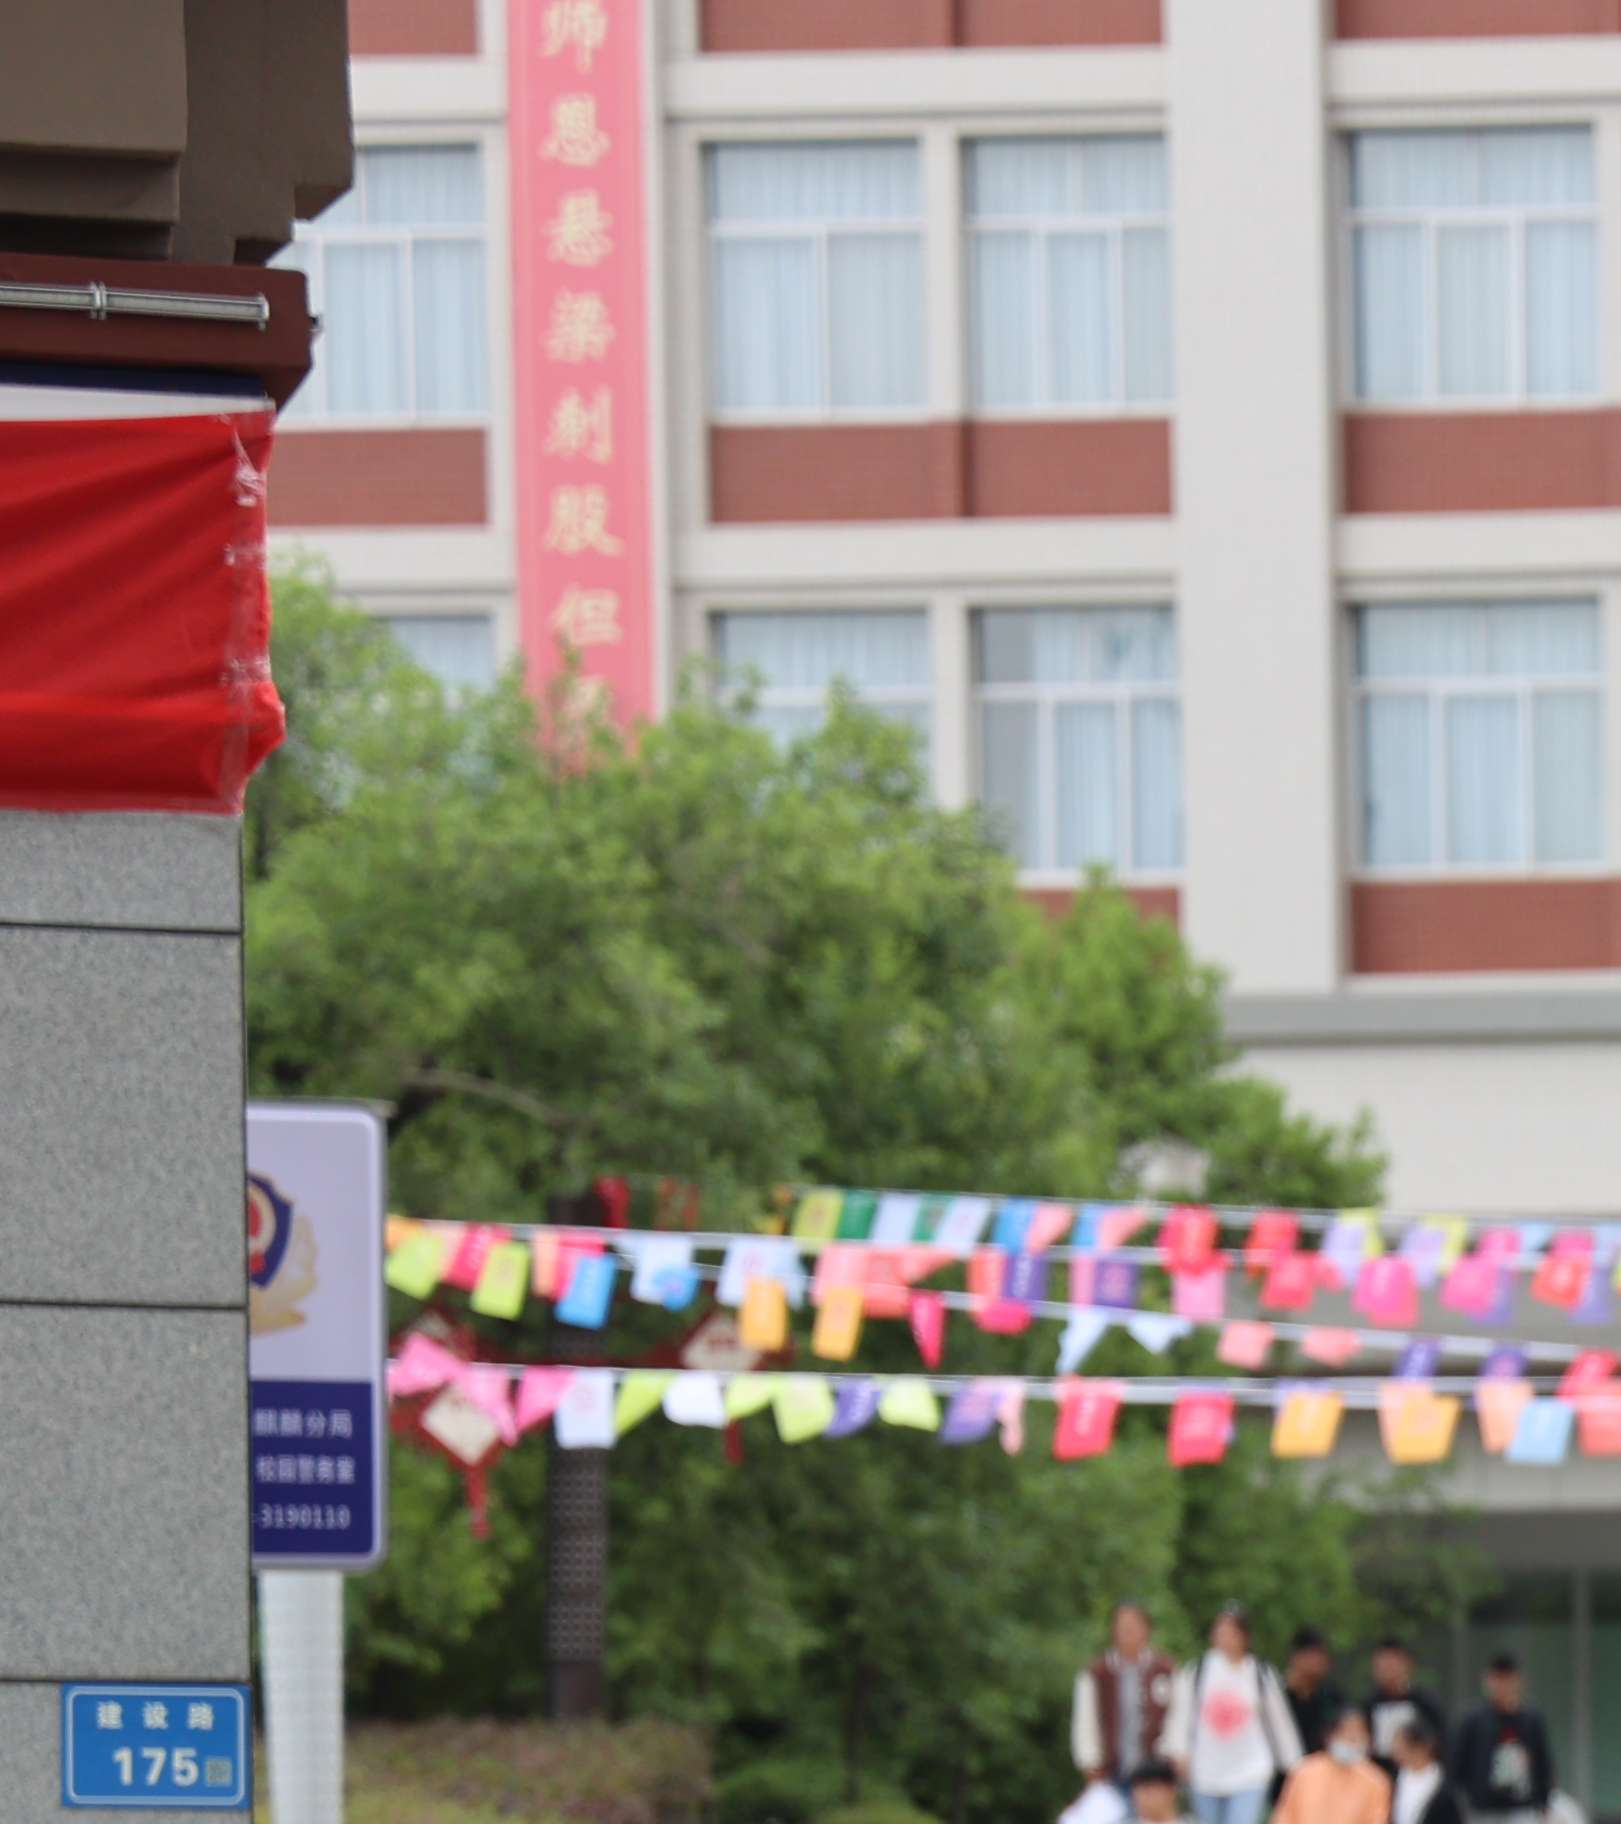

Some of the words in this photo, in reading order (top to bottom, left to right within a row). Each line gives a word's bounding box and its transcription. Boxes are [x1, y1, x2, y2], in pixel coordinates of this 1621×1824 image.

[97, 1700, 214, 1731] 建设路
[113, 1746, 199, 1787] 175
